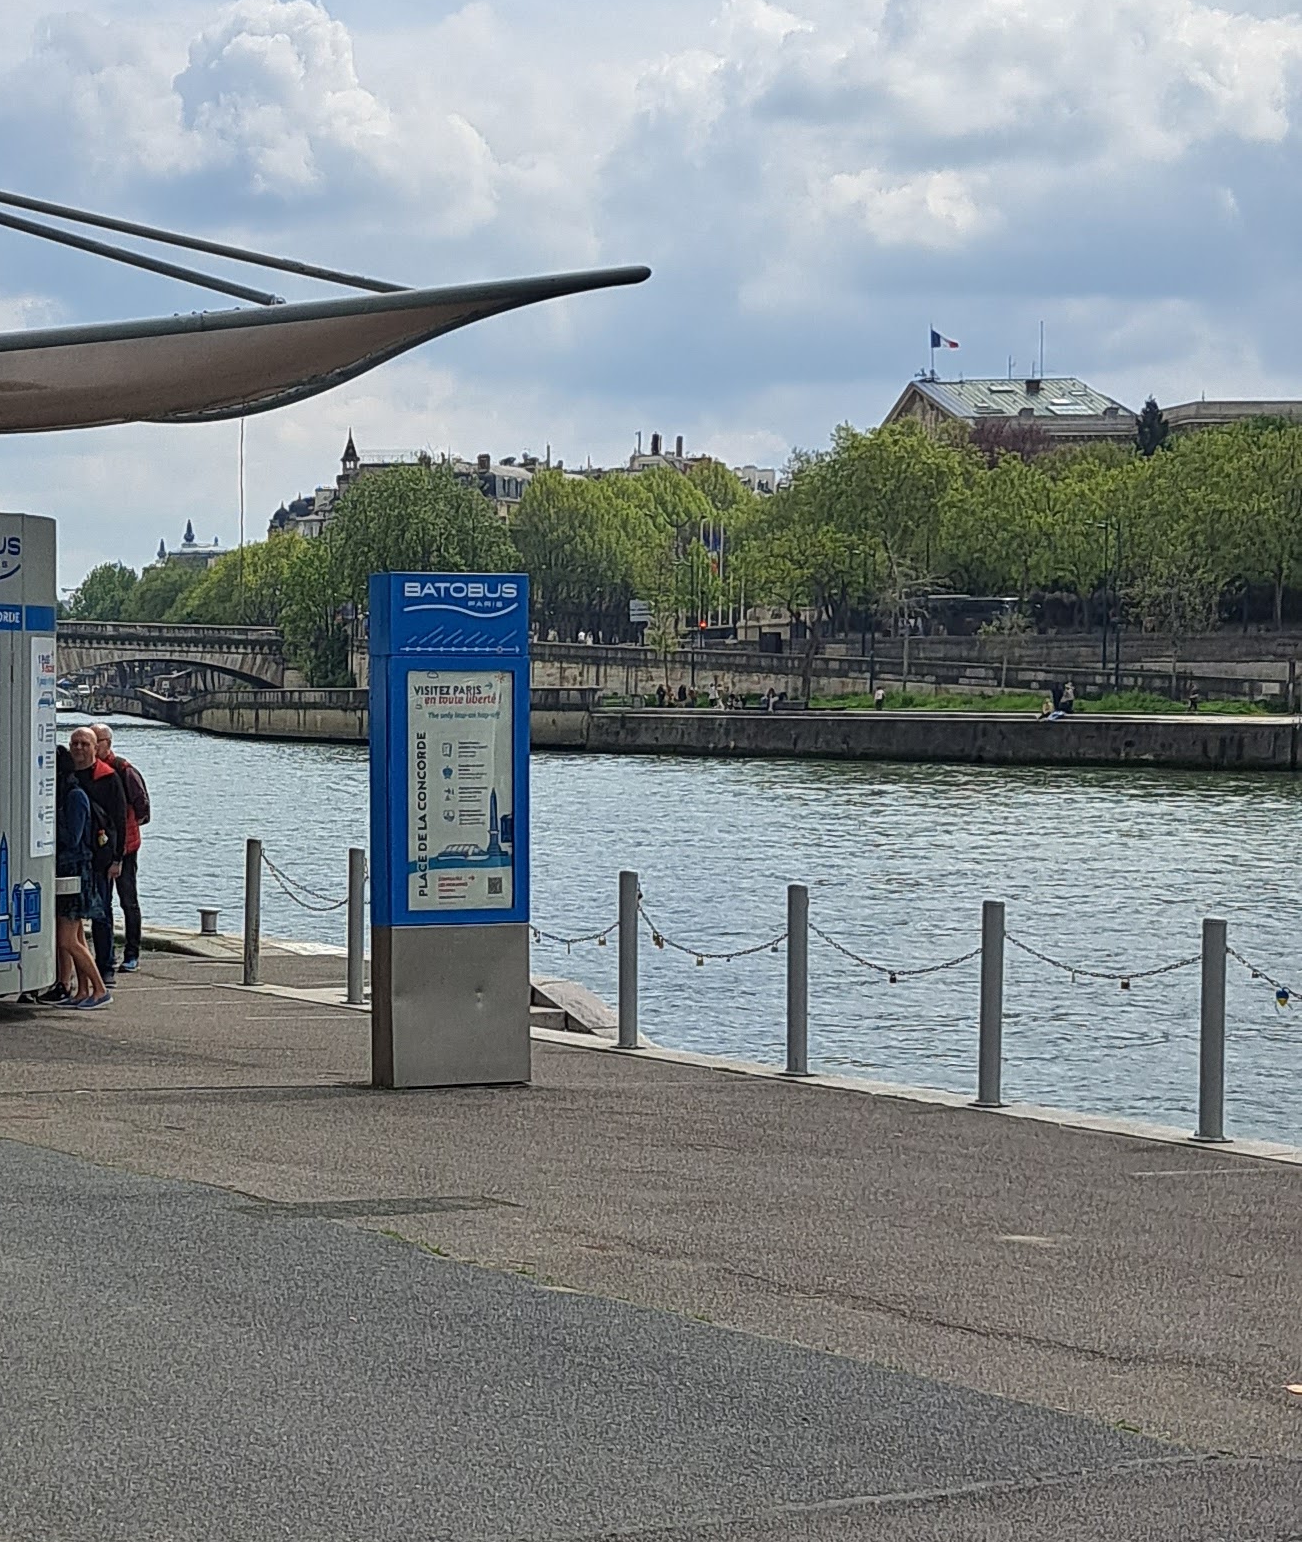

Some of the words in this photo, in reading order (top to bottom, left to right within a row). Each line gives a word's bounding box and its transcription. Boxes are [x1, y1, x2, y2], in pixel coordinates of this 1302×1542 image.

[404, 582, 518, 598] BATOBUS
[467, 600, 503, 608] PARIS
[413, 685, 451, 696] VISITEZ
[453, 685, 482, 696] PARIS
[424, 695, 436, 705] en
[438, 695, 464, 705] toute
[417, 731, 427, 811] CONCORDE
[418, 813, 427, 830] LA
[418, 833, 428, 851] DE
[418, 854, 428, 897] PLACE
